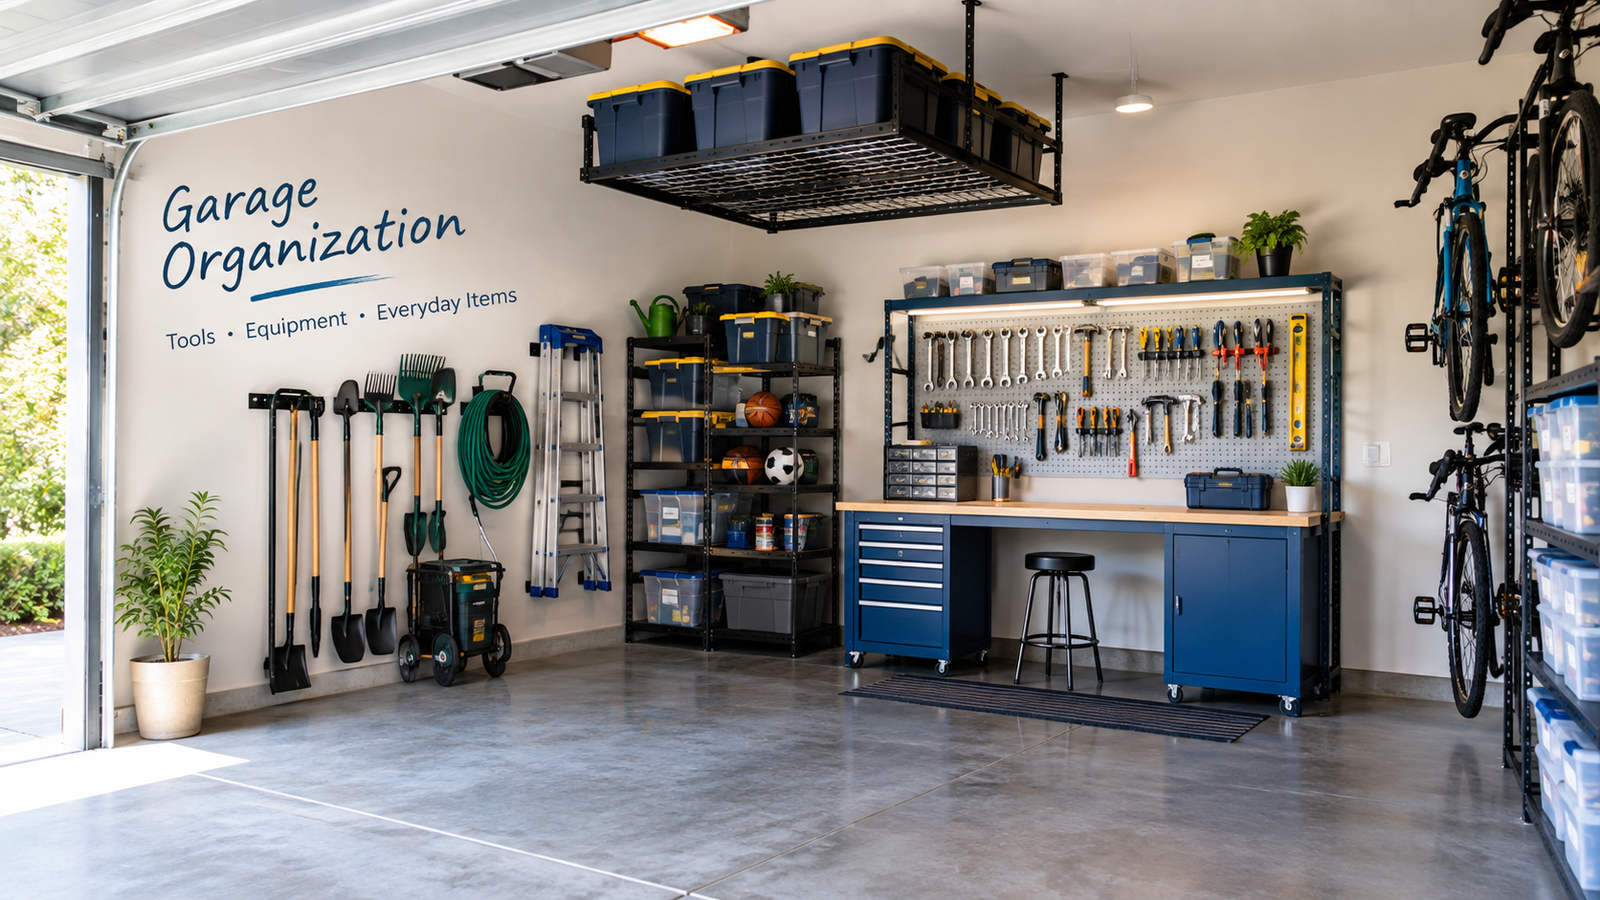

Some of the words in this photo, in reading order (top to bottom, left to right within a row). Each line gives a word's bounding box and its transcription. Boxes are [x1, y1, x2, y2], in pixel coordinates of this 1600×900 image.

[163, 178, 318, 232] Garage
[162, 207, 466, 292] Organization
[166, 329, 216, 350] Tools
[246, 311, 348, 340] Equipment
[377, 296, 461, 321] Everyday
[466, 290, 518, 309] Items
